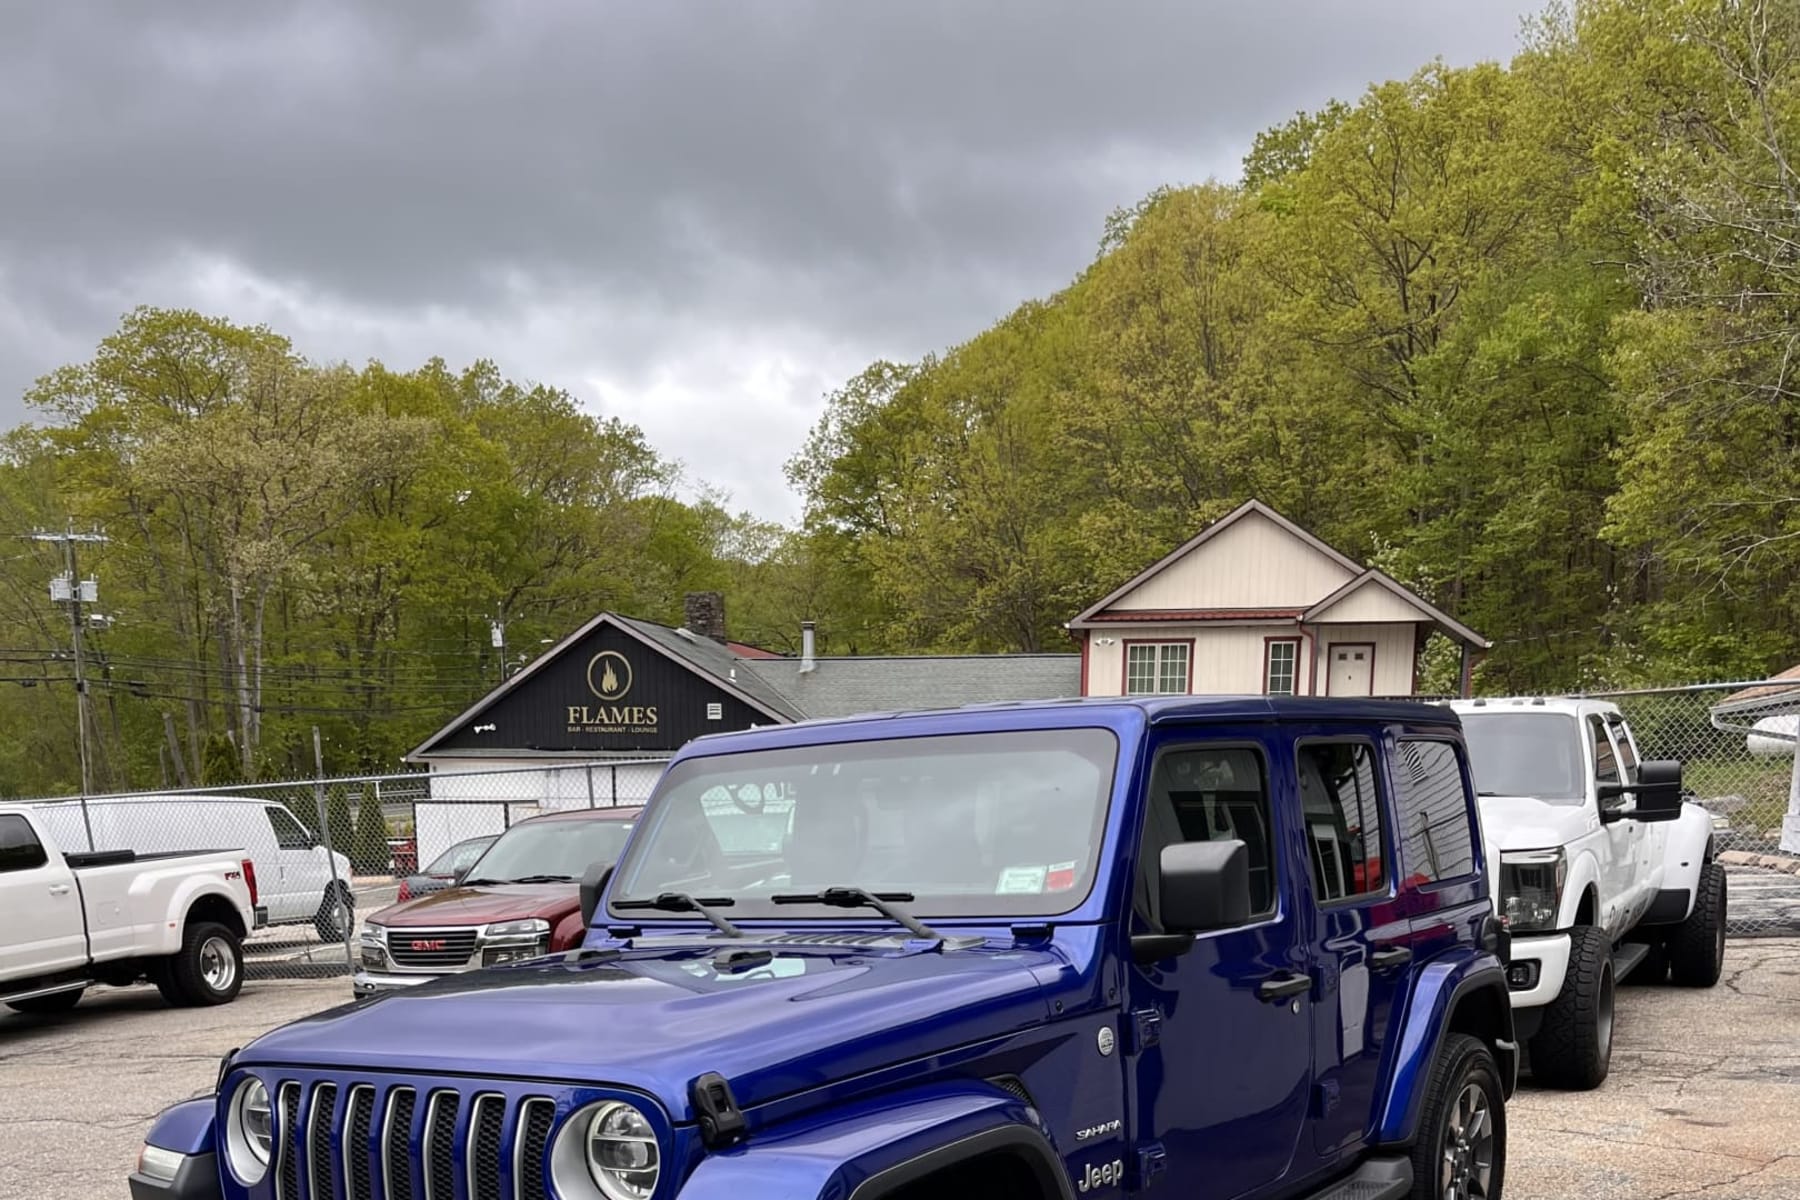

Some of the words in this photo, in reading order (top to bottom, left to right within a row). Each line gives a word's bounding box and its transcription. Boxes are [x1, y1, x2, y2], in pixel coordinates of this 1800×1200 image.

[567, 706, 658, 725] FLAMES
[411, 940, 447, 951] GMC
[1076, 1120, 1121, 1140] SAHARA
[1078, 1159, 1124, 1192] Jeep
